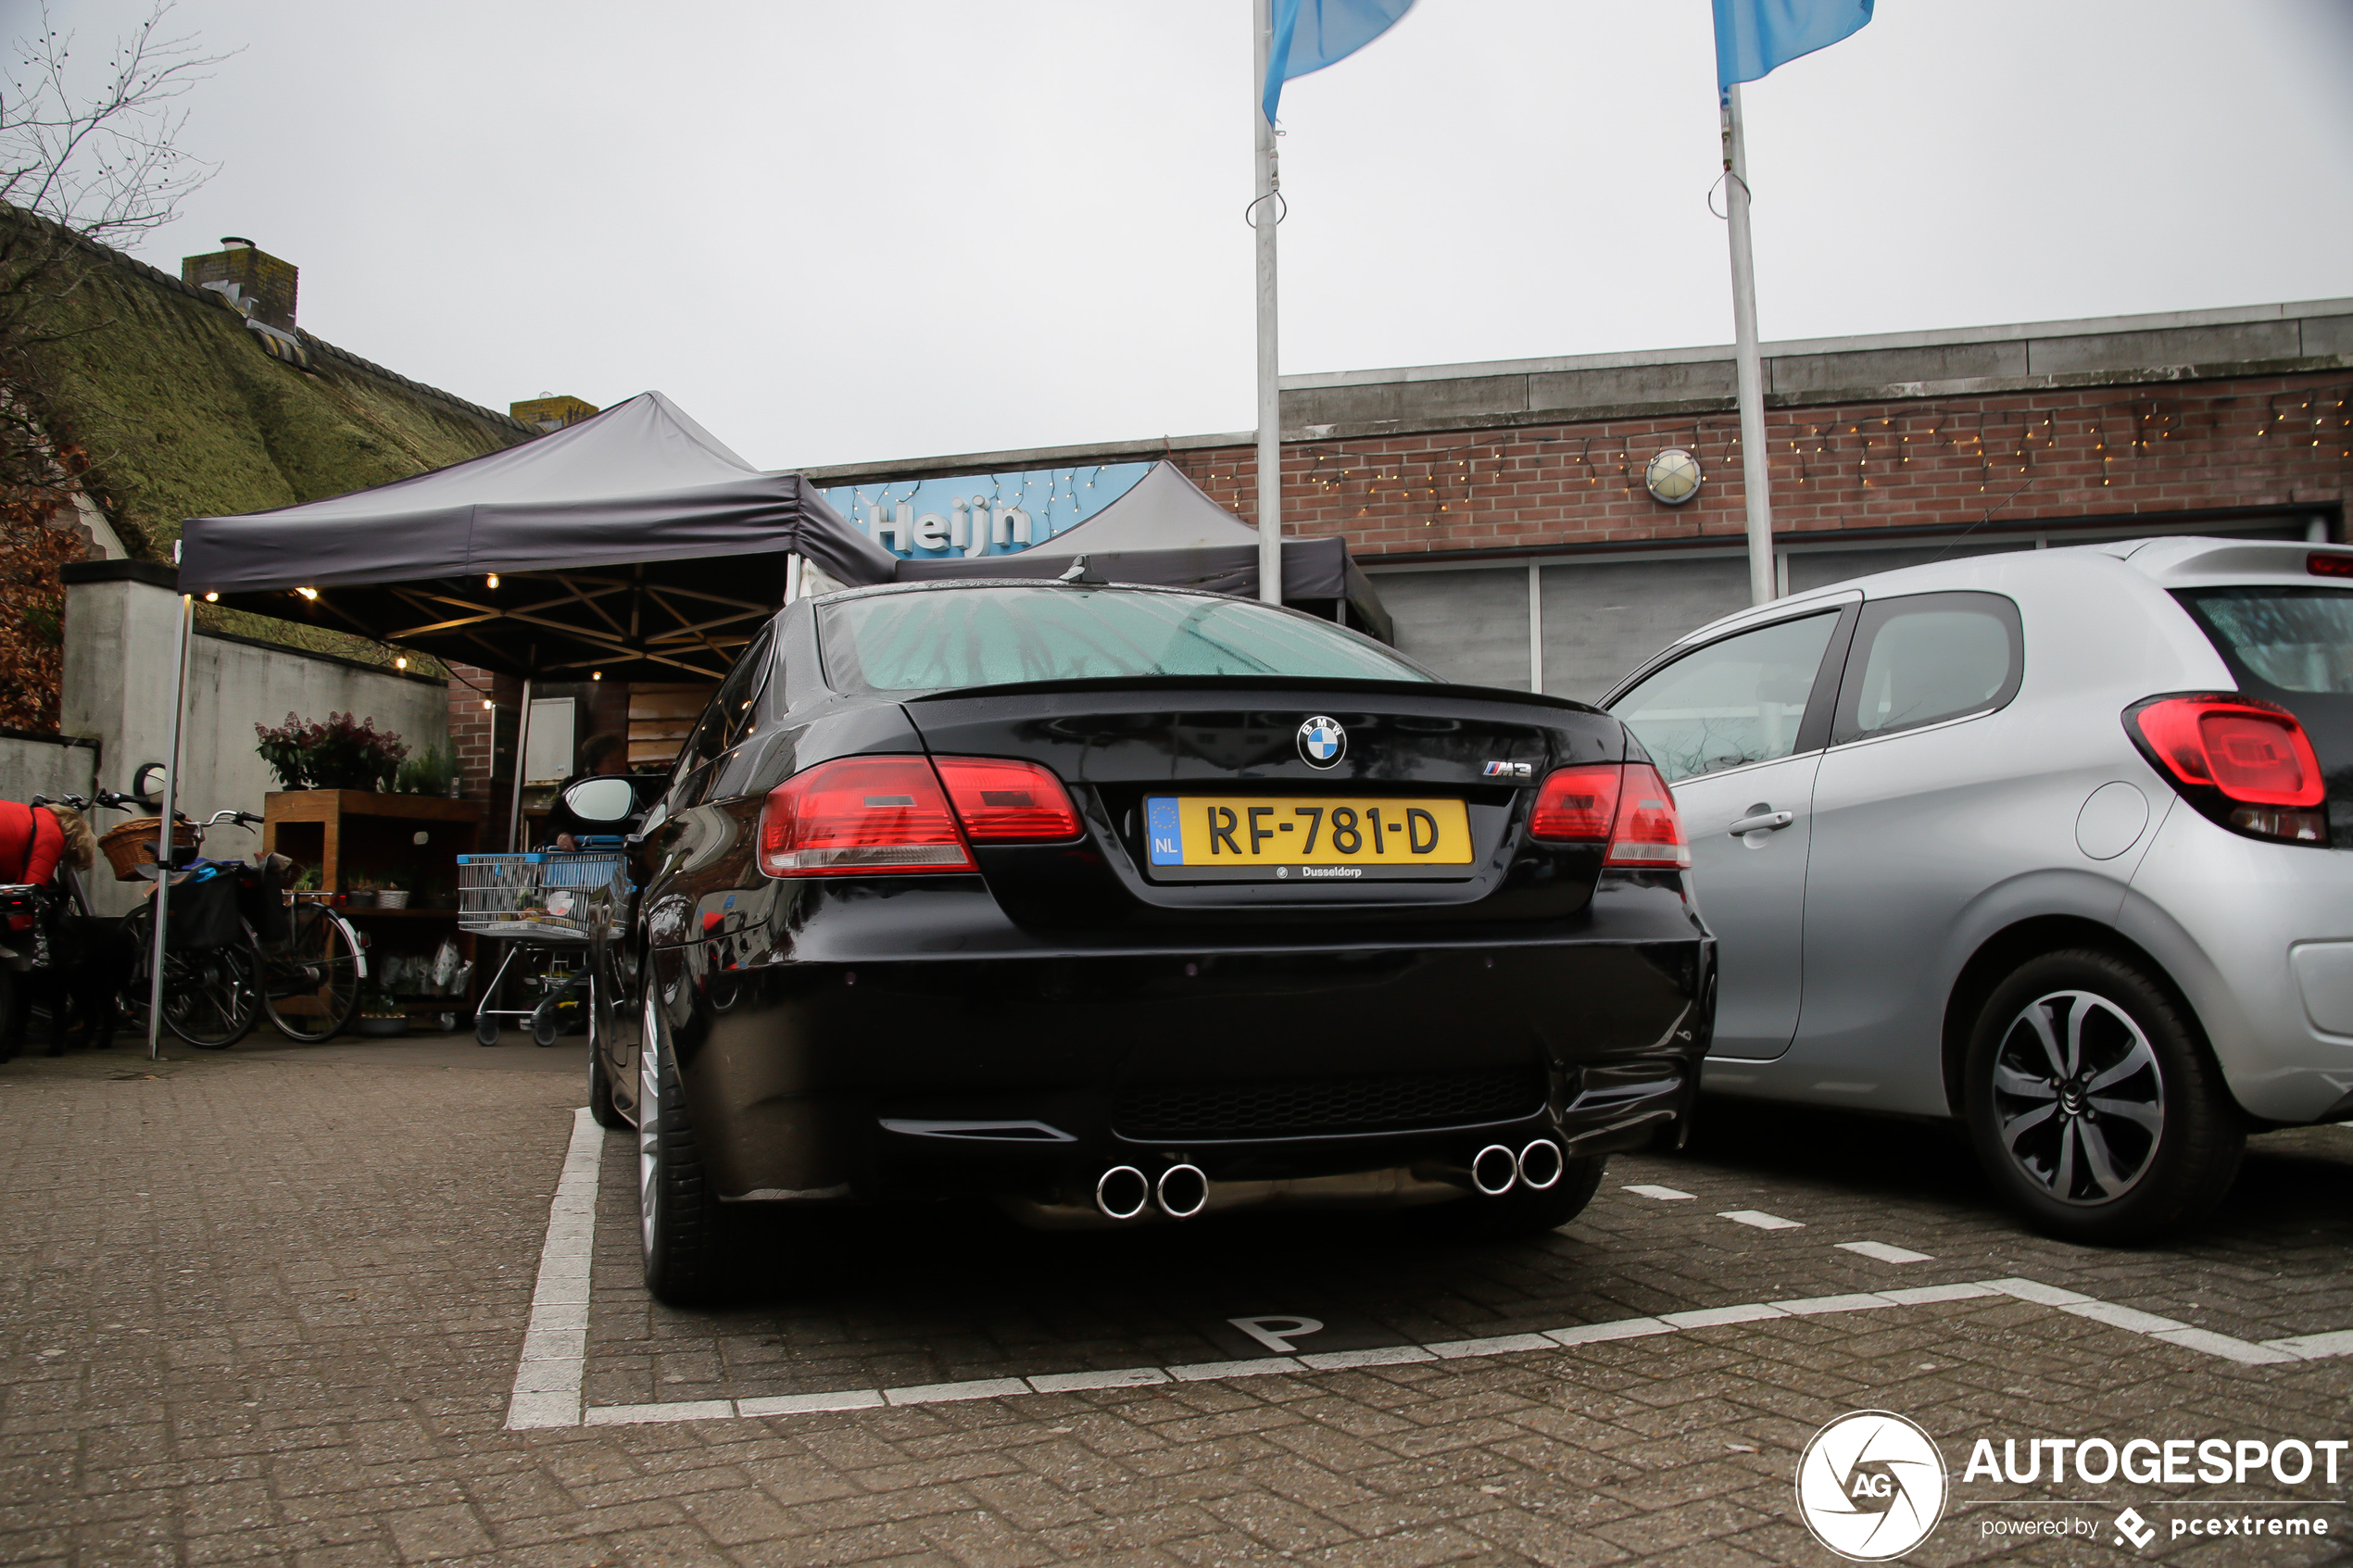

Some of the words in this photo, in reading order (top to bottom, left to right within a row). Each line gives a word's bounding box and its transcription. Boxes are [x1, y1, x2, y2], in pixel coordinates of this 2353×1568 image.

[869, 495, 1032, 558] Heijn
[1302, 718, 1342, 736] BMW
[1483, 760, 1532, 778] M3
[1208, 806, 1439, 855] RF-781-D
[1155, 838, 1178, 853] NL
[1302, 866, 1363, 879] Dusseldorp
[1226, 1315, 1325, 1352] P
